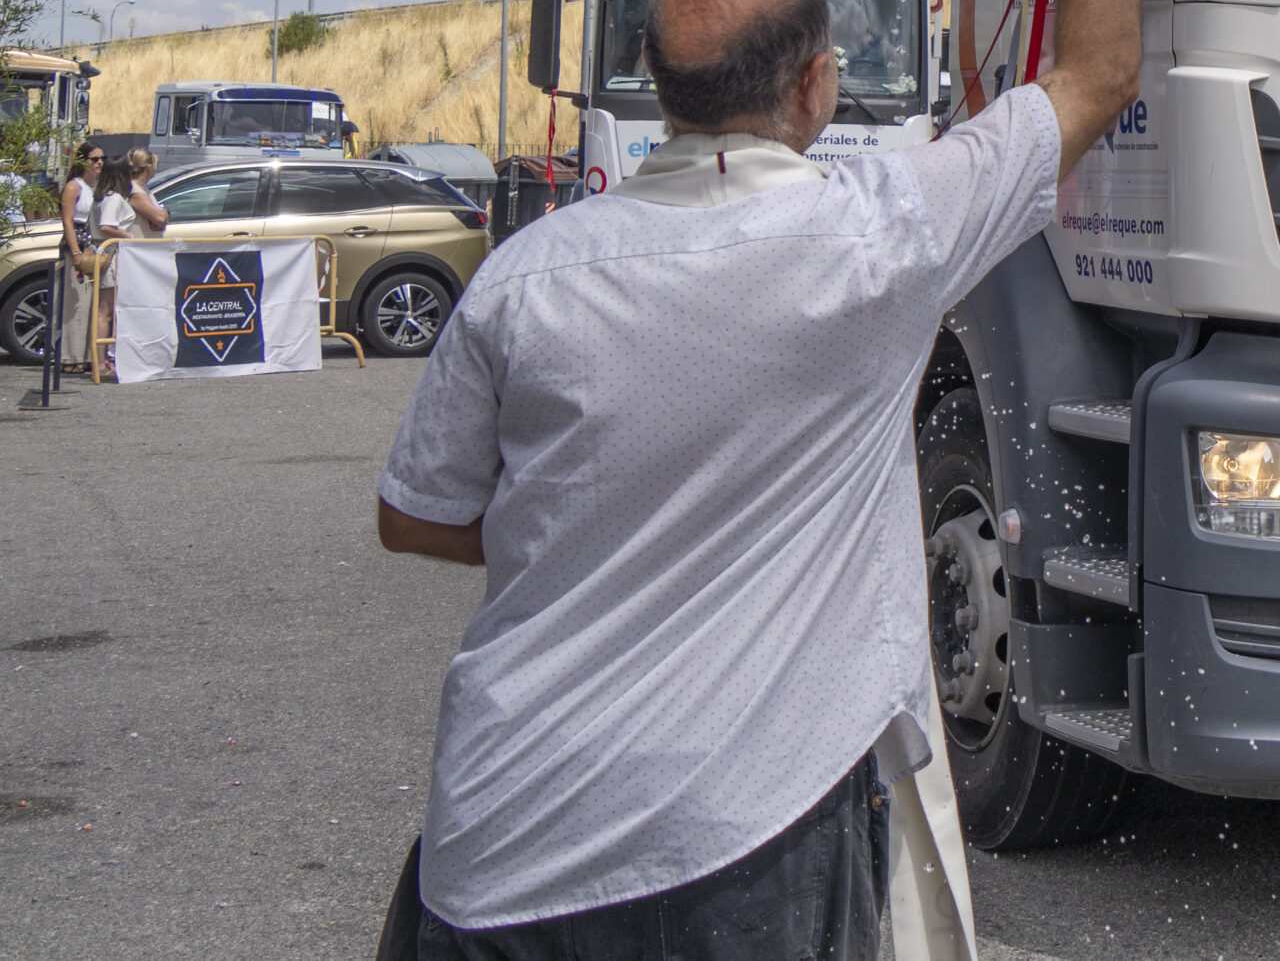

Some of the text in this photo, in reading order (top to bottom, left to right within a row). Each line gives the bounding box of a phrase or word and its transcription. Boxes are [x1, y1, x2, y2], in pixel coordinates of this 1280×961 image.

[815, 134, 879, 146] eriales de
[1062, 210, 1165, 238] elreque@elreque.com
[1075, 253, 1154, 284] 921 444 000
[196, 301, 243, 312] LA CENTRAL
